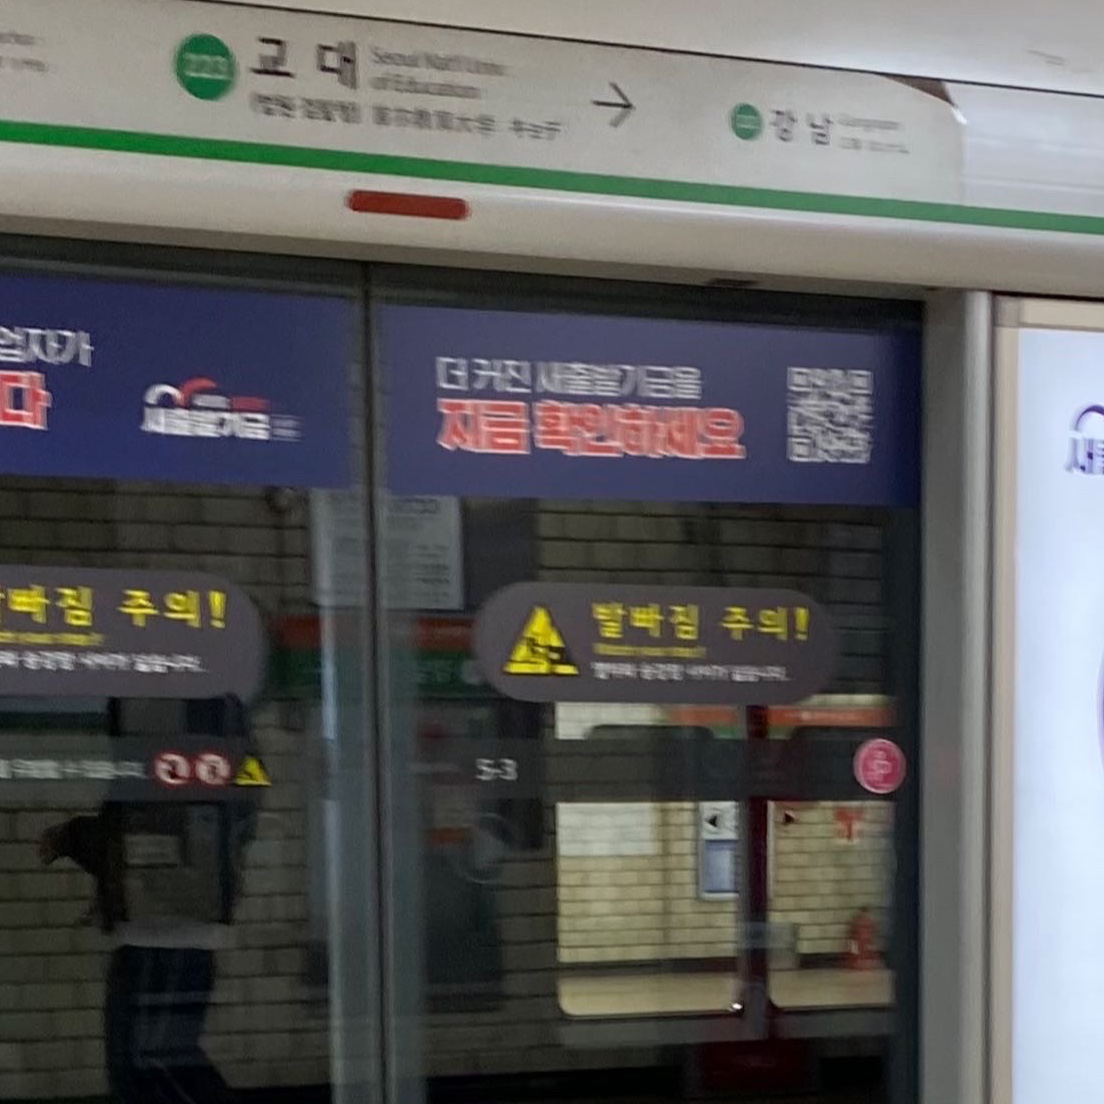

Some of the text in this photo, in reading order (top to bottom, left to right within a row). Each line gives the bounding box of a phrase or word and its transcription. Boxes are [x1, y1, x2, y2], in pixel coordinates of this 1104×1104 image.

[437, 398, 746, 459] 지금 확인하세요
[0, 583, 227, 629] 빠짐 주의!
[721, 605, 810, 640] 주의!
